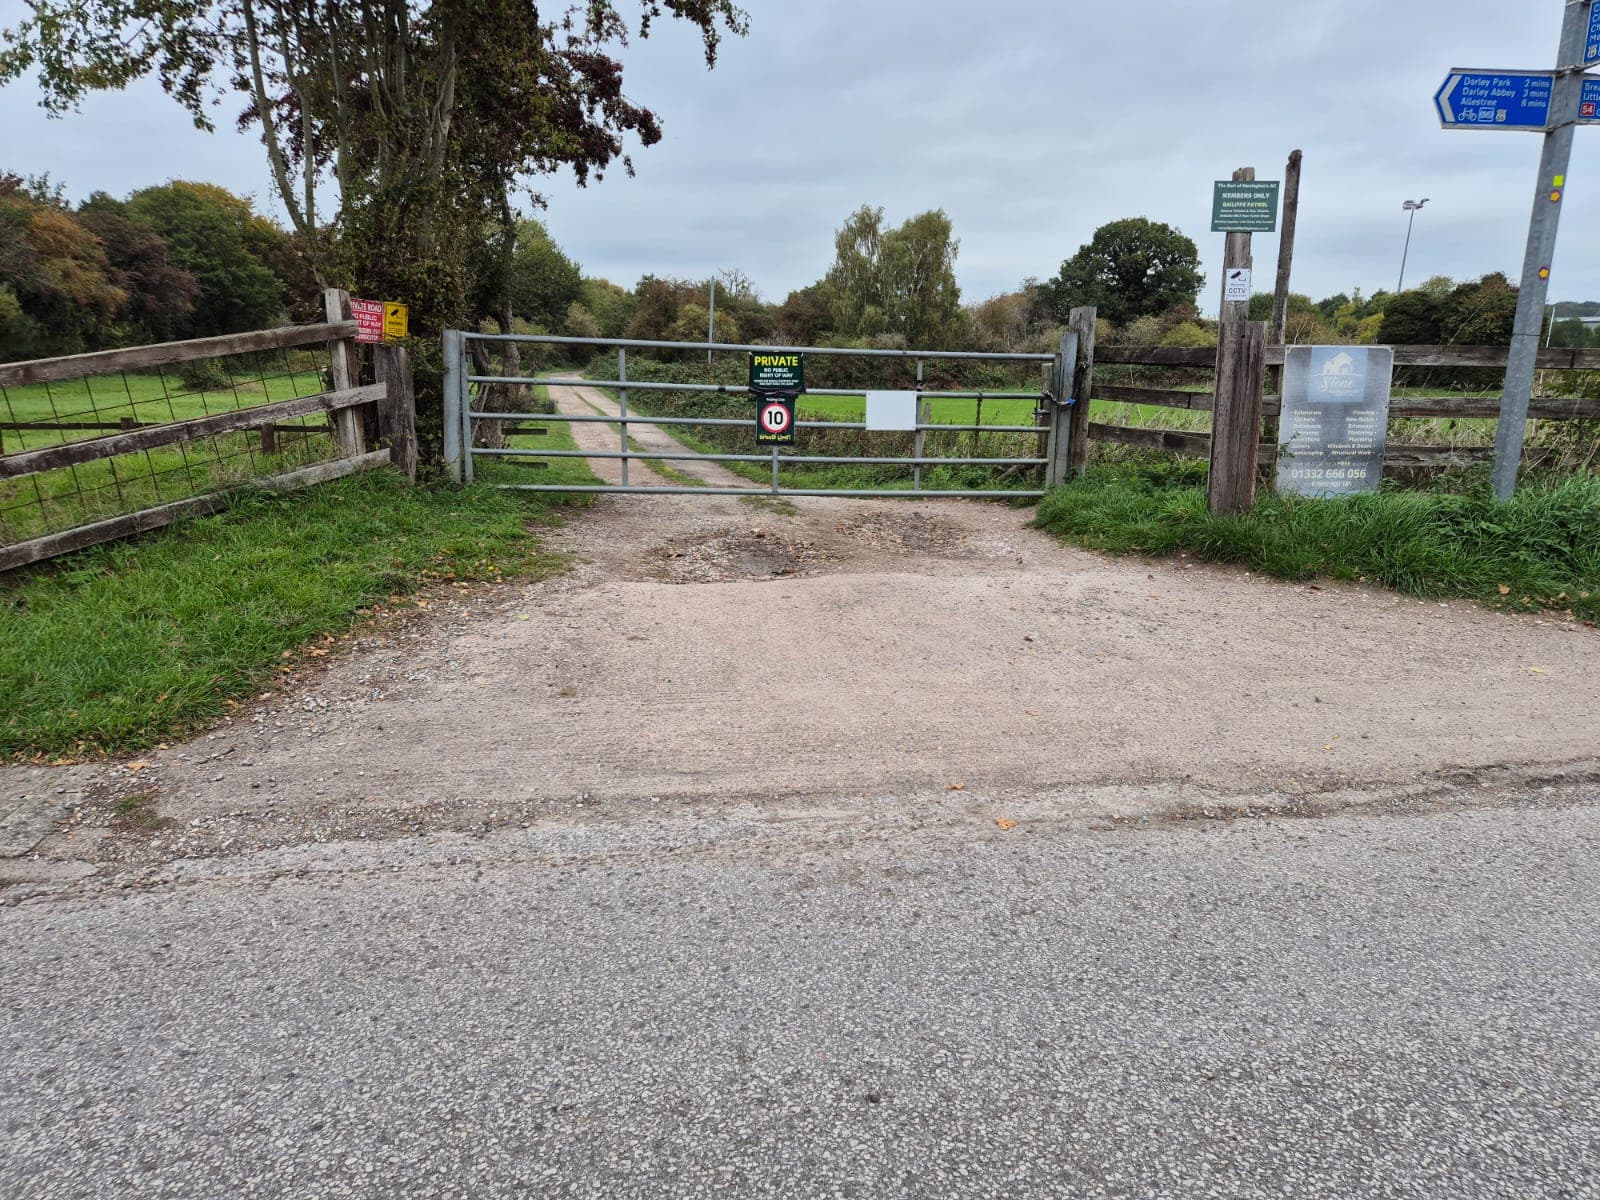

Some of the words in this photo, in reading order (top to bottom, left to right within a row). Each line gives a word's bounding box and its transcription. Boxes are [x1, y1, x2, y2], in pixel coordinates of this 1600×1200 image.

[1464, 77, 1490, 87] Darley
[1493, 78, 1511, 87] Park
[1525, 78, 1530, 87] 2
[1531, 80, 1550, 88] mins
[1462, 87, 1489, 97] Darley
[1491, 88, 1516, 98] Abbey
[1530, 90, 1549, 98] mins
[1461, 98, 1497, 106] Allestree
[1581, 105, 1593, 114] 54
[368, 303, 382, 313] ROAD
[754, 355, 799, 366] PRIVATE
[768, 410, 783, 425] 10
[1291, 469, 1322, 479] 01332
[1326, 469, 1345, 479] 666
[1347, 469, 1367, 479] 056
